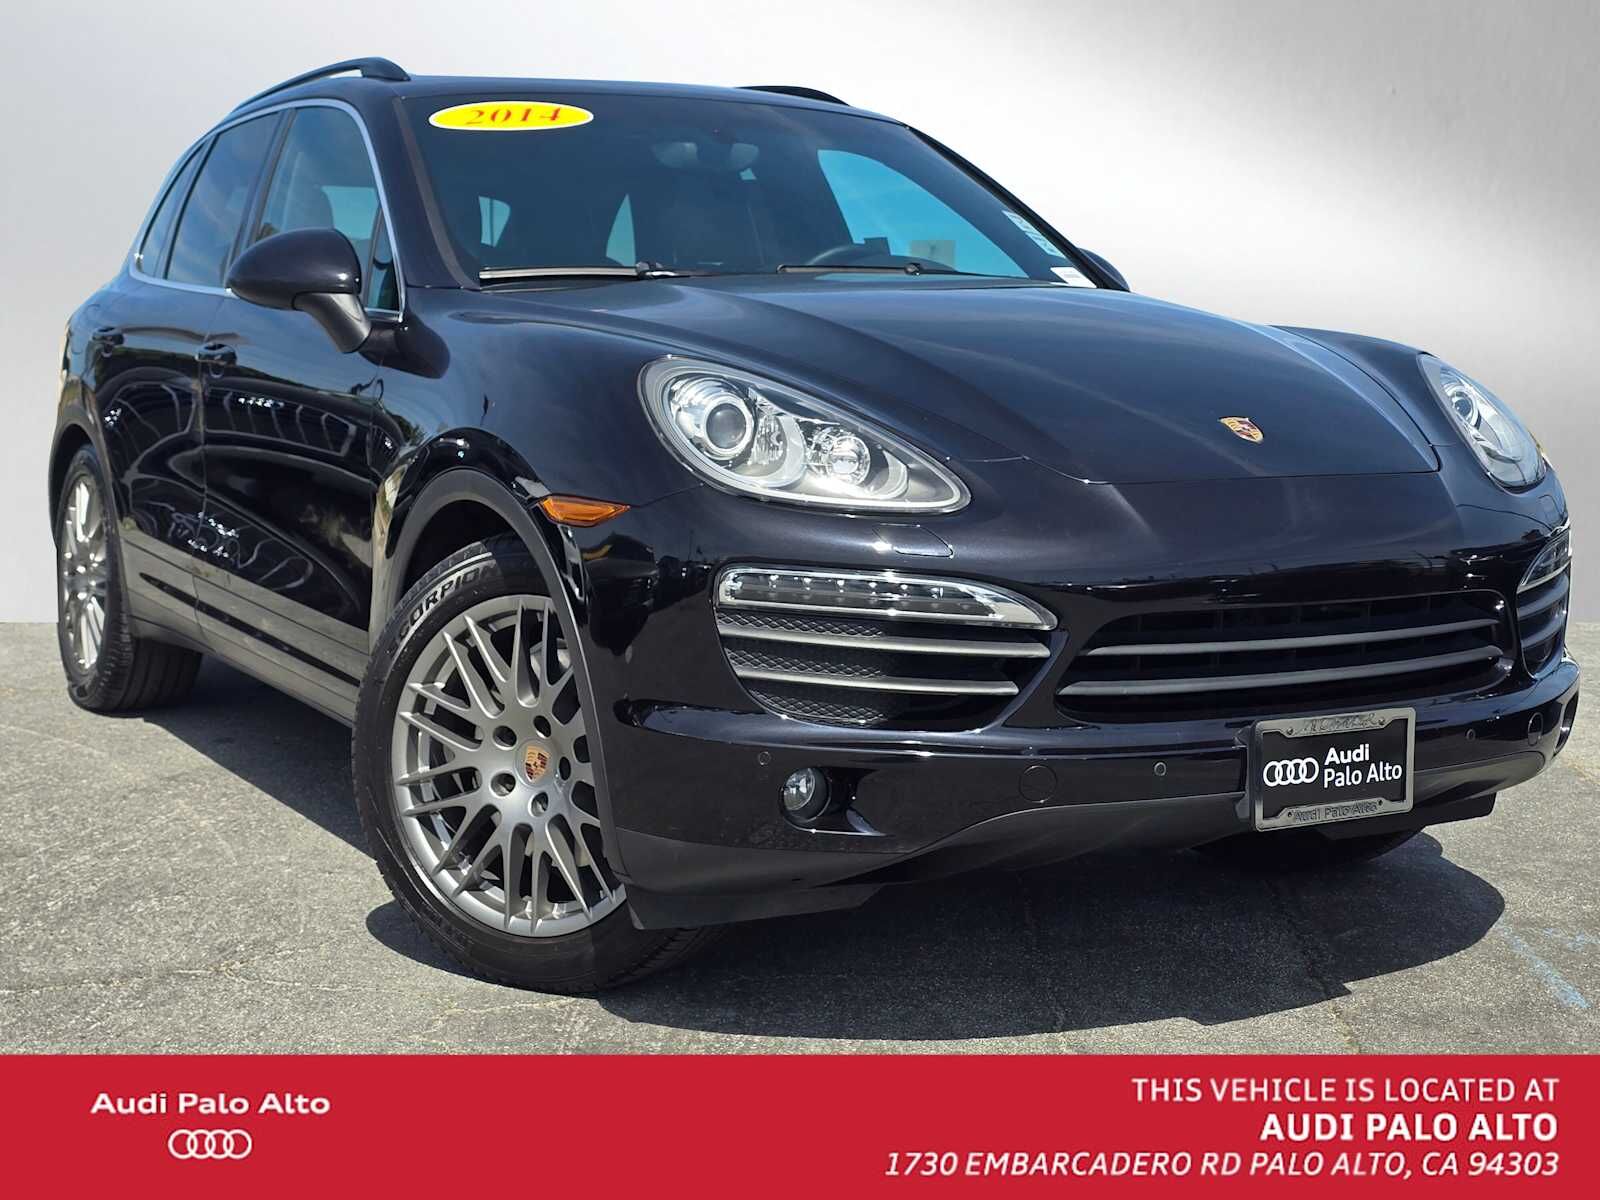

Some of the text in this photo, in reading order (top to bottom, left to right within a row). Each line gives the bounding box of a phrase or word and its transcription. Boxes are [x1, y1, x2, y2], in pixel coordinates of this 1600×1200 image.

[466, 107, 561, 125] 2014
[1324, 743, 1370, 766] Audi
[1323, 761, 1403, 789] Palo Alto
[1295, 800, 1377, 821] Audi Palo Alto
